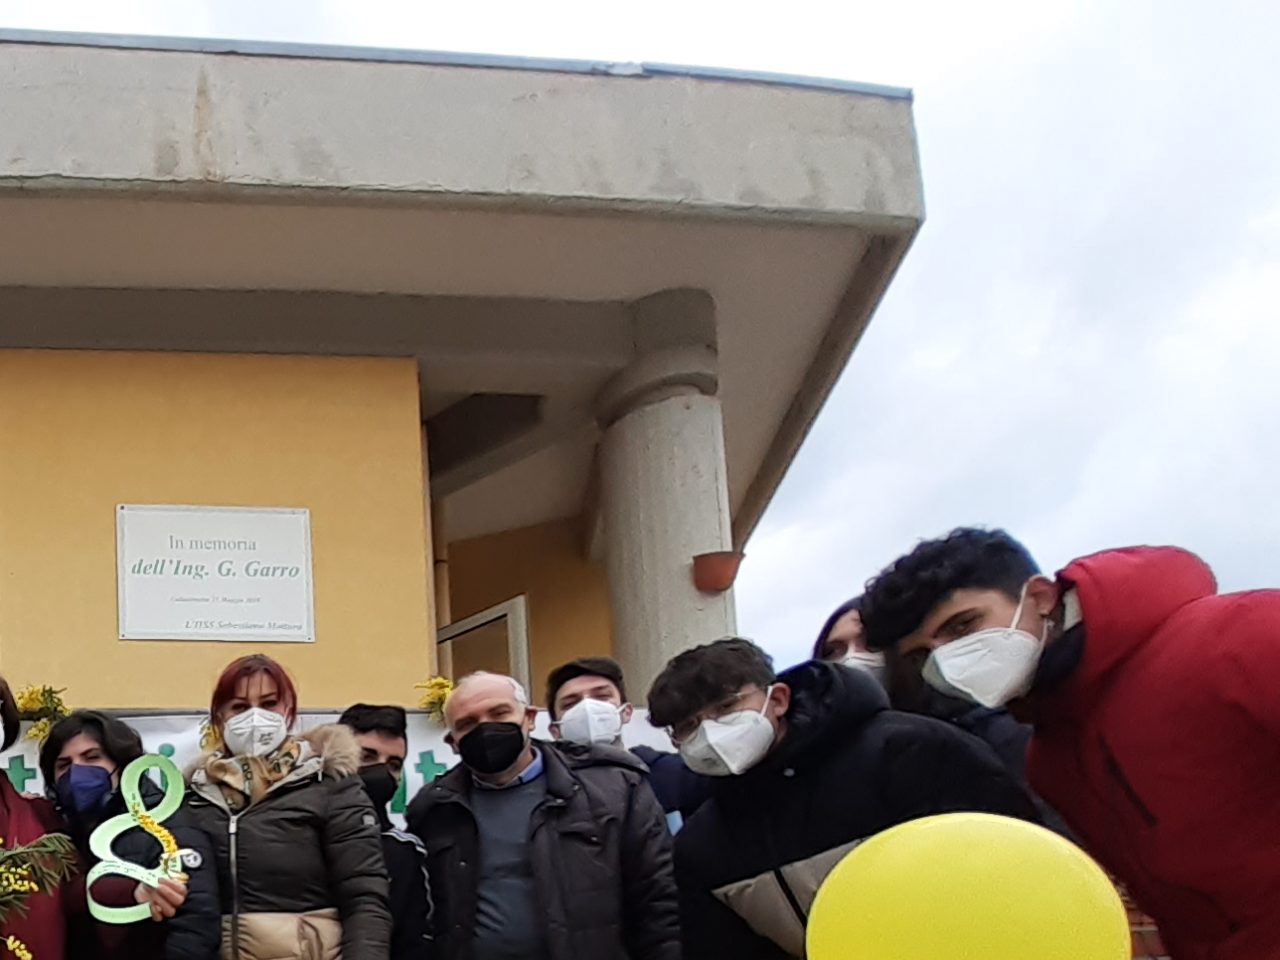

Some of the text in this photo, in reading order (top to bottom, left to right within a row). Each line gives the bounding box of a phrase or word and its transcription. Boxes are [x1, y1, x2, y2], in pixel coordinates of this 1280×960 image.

[169, 535, 257, 551] In memoria
[131, 558, 300, 579] dell'Ing. G. Garro
